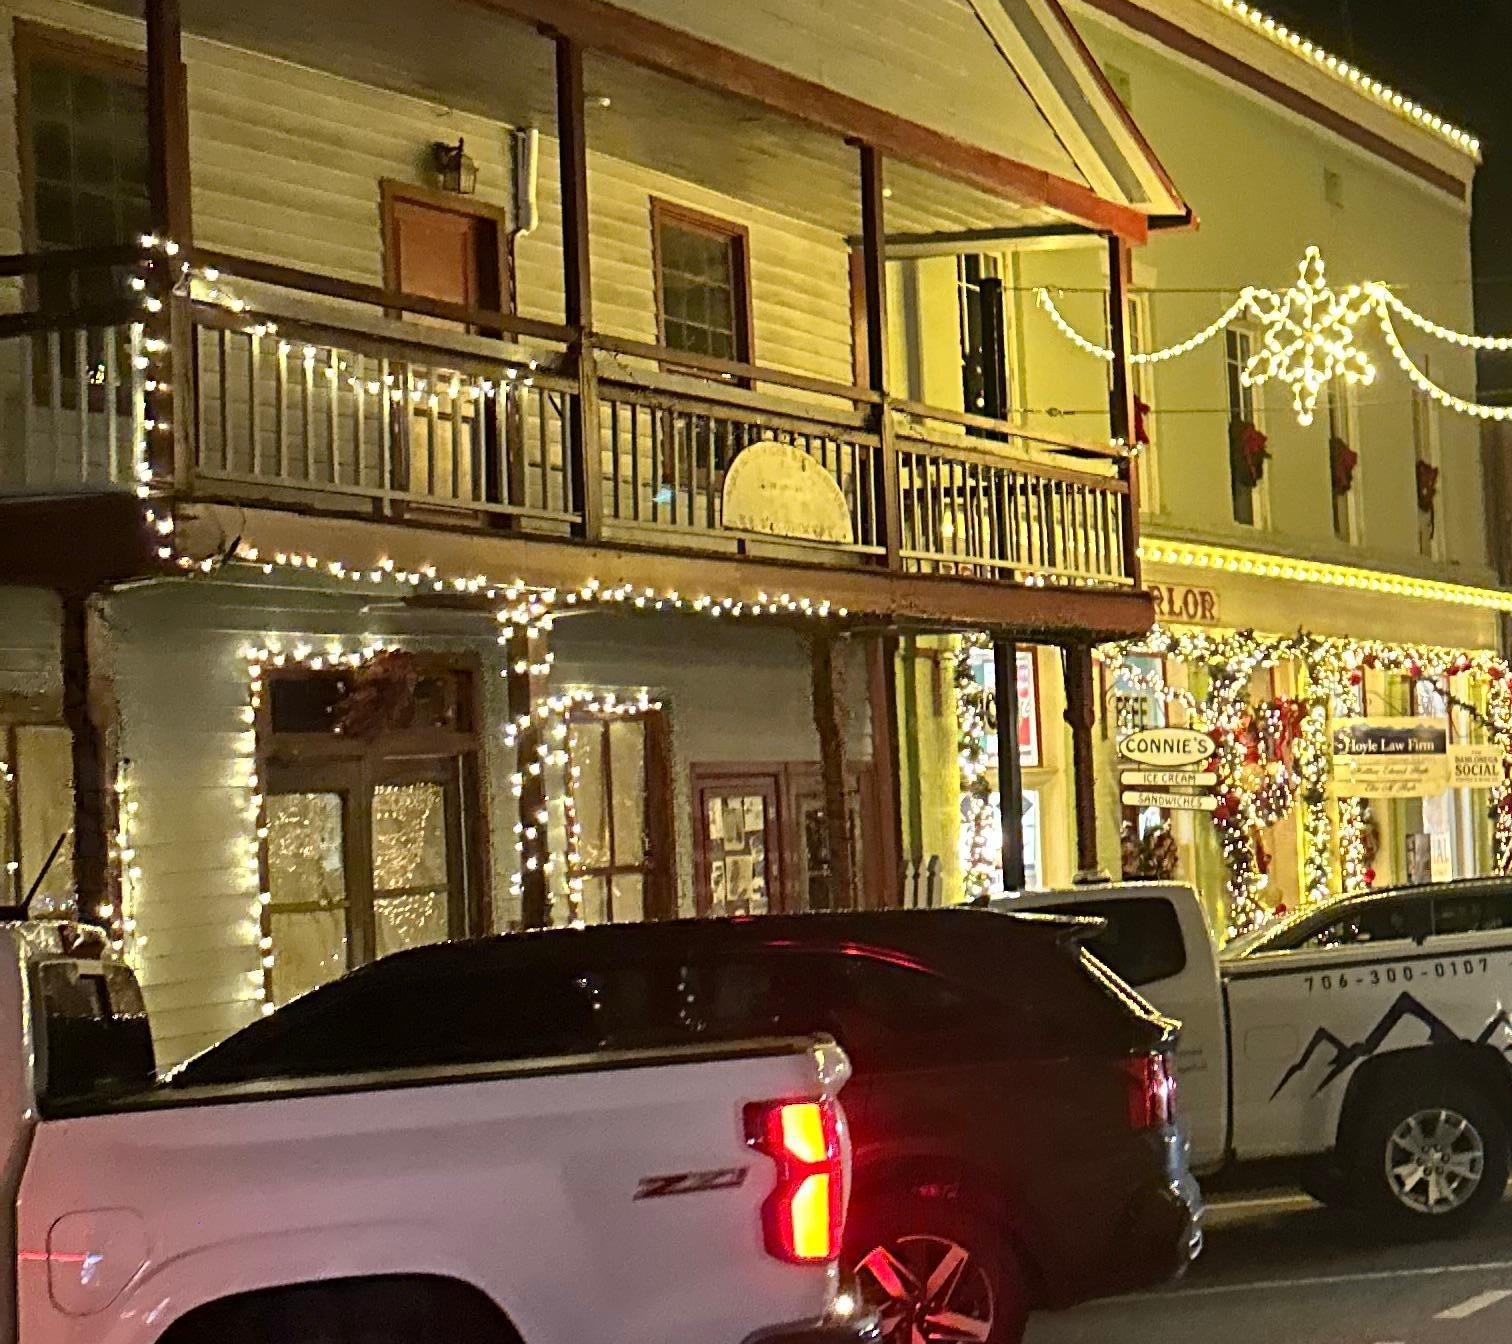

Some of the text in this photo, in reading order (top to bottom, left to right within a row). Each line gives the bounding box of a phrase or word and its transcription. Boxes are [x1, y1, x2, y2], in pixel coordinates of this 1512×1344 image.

[1126, 737, 1208, 754] CONNIE'S
[1380, 738, 1404, 752] Law
[1408, 738, 1434, 752] Firm
[1455, 764, 1499, 776] SOCIAL
[1143, 772, 1196, 784] ICE CREAM
[1138, 794, 1202, 808] SANDWICHES
[1303, 958, 1489, 992] 706-300-0107
